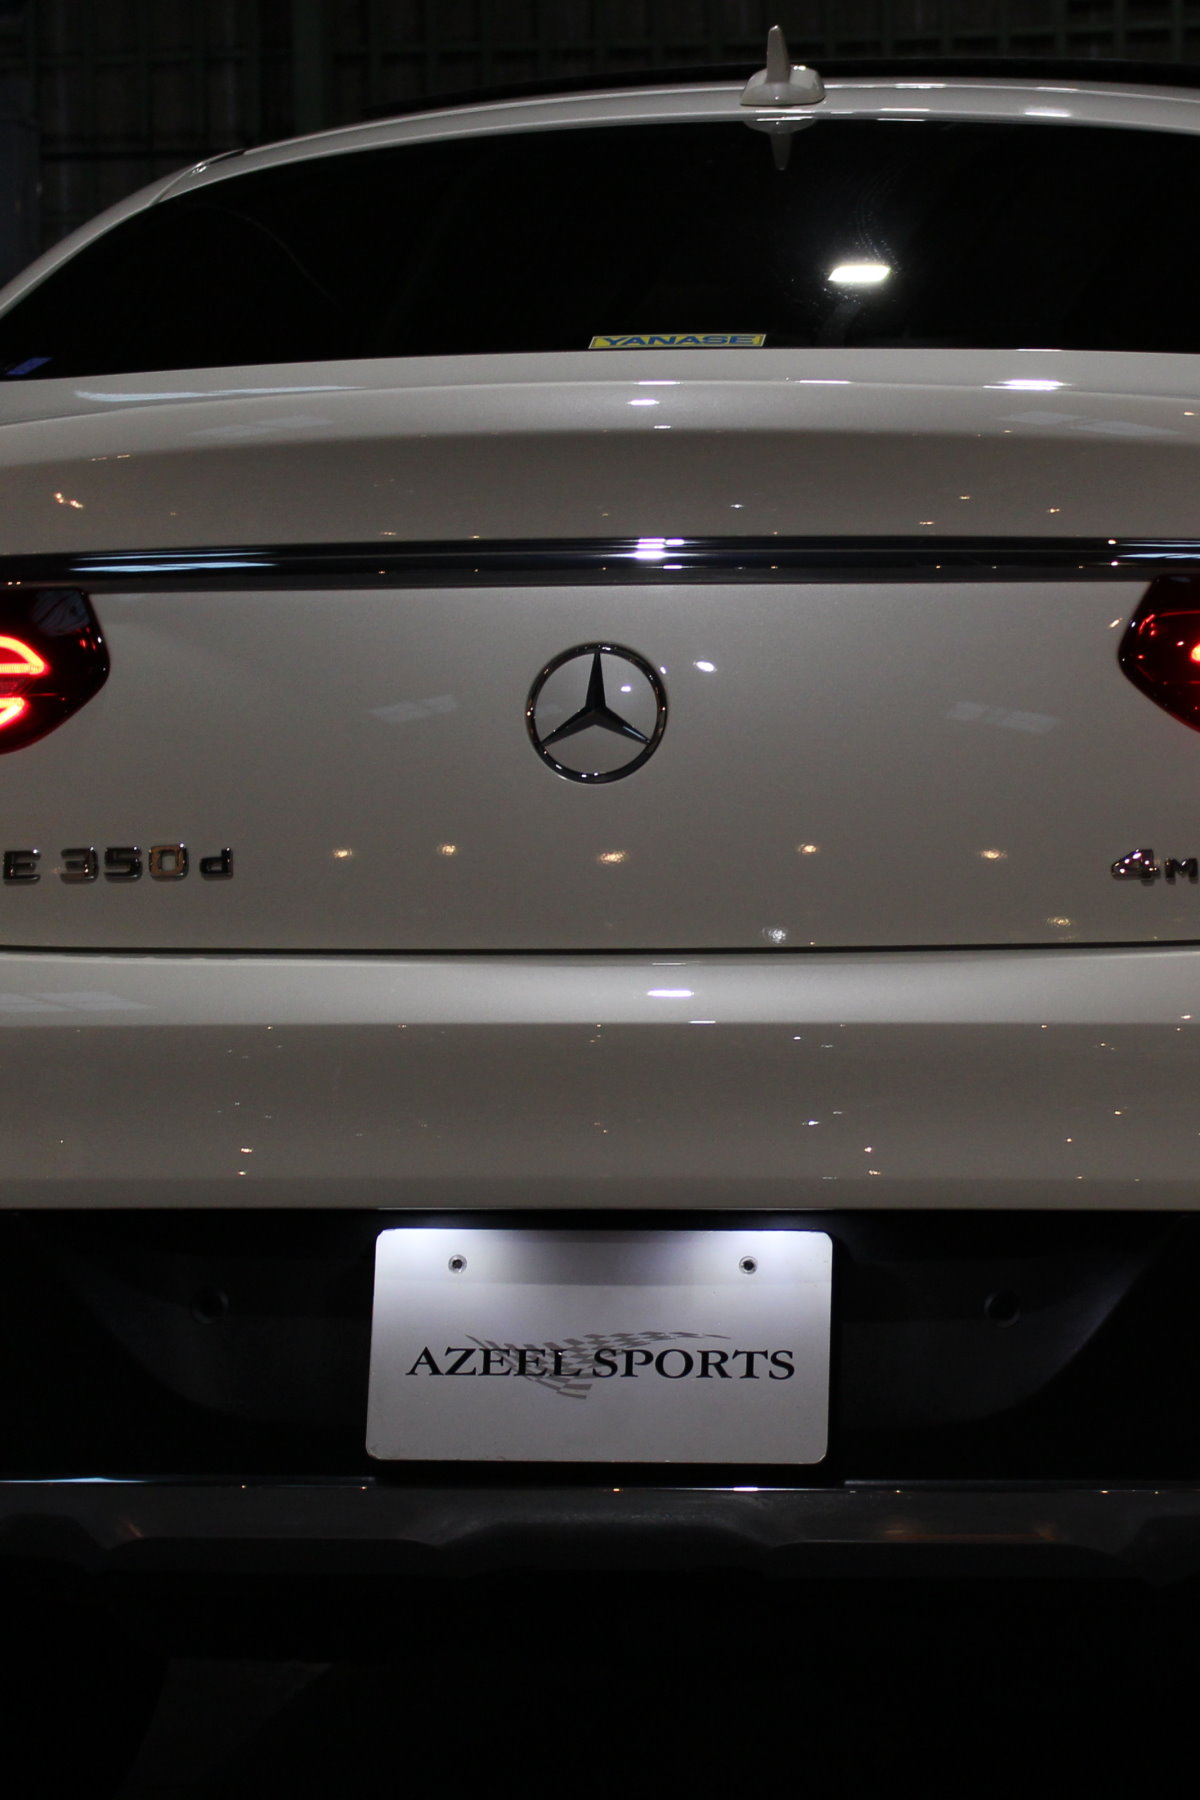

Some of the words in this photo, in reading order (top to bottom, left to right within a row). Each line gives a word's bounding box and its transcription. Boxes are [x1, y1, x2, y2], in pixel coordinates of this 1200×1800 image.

[603, 335, 754, 346] YANASE
[405, 1346, 582, 1377] AZEEL
[592, 1347, 795, 1380] SPORTS
